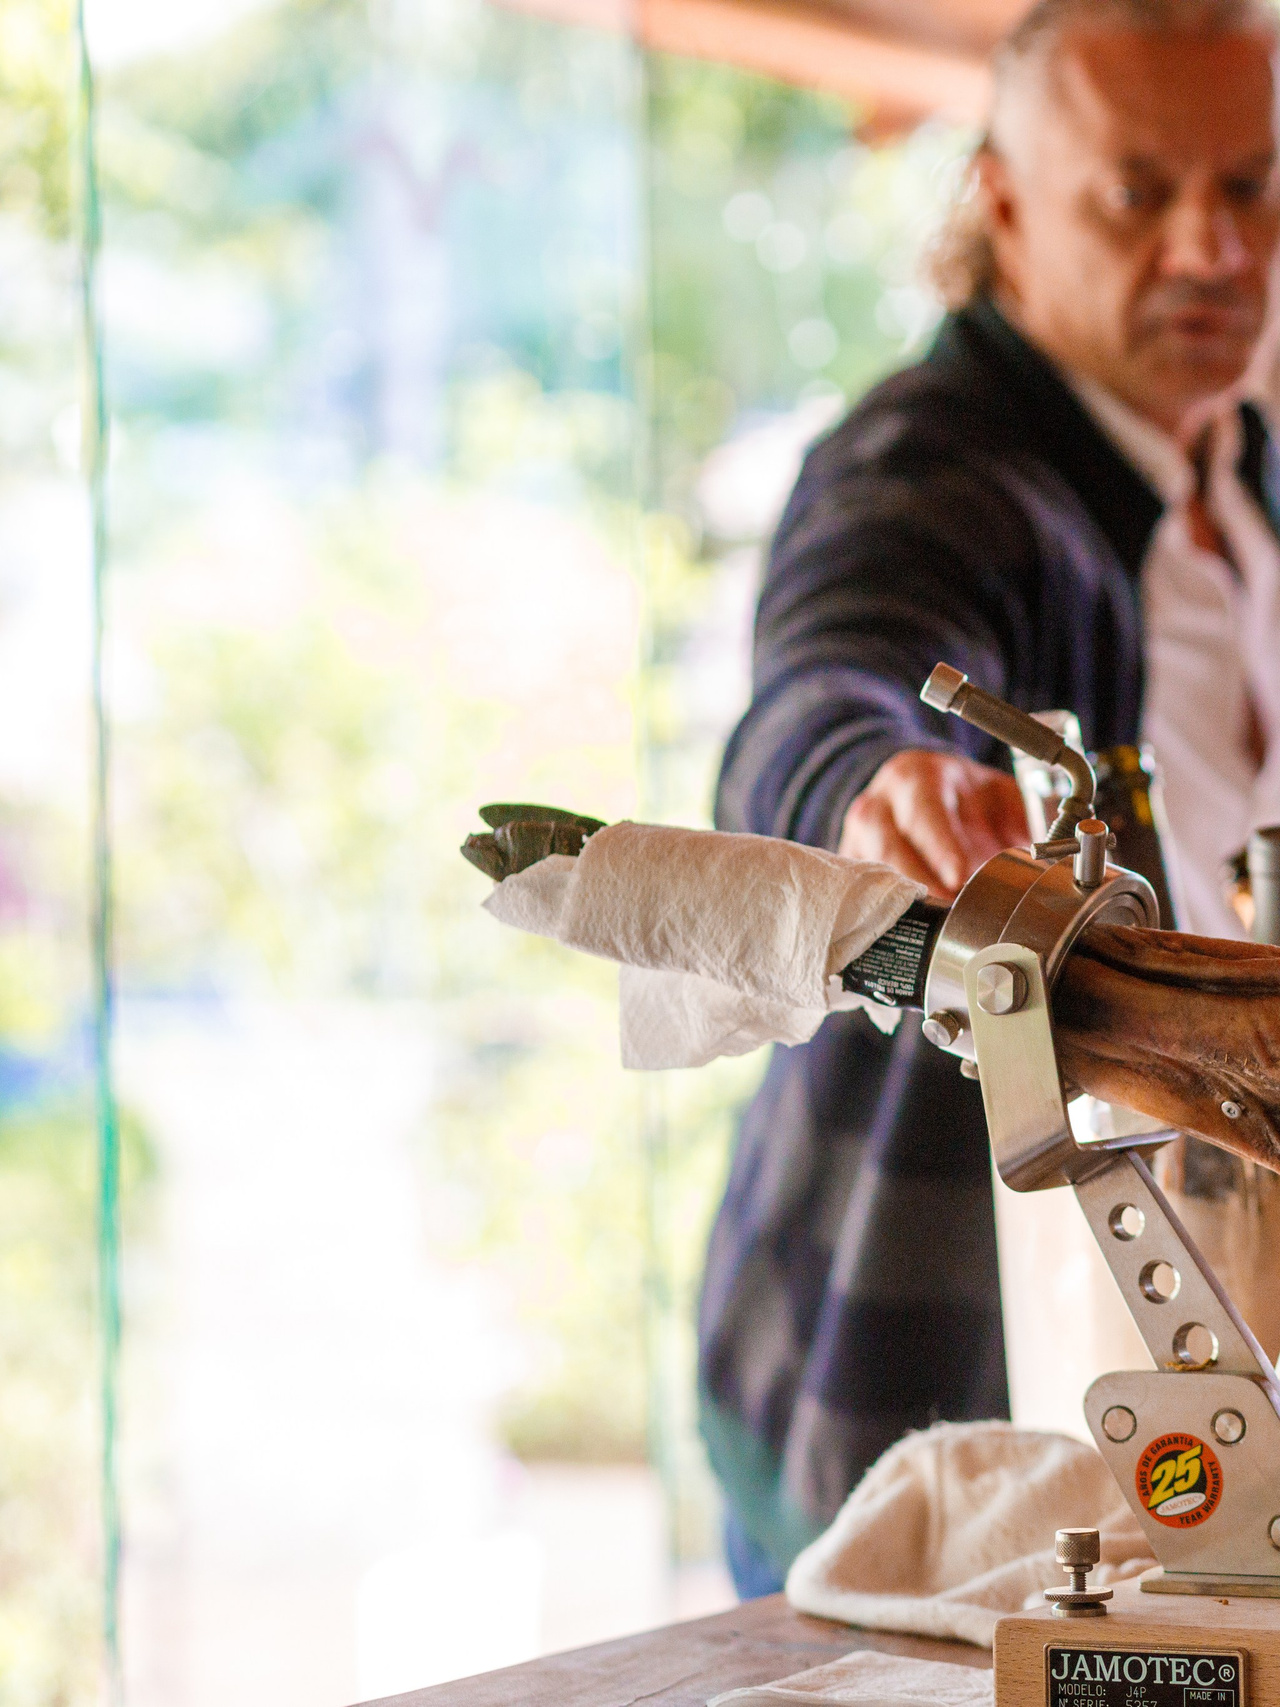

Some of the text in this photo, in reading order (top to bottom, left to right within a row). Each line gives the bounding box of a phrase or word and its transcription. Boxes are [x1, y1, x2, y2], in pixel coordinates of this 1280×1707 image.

[1142, 1454, 1153, 1468] DE
[1148, 1443, 1204, 1511] 25
[1179, 1461, 1221, 1525] YEAR WARRANTY
[1058, 1683, 1147, 1699] MODELO: J4P
[1189, 1691, 1226, 1701] MADE IN
